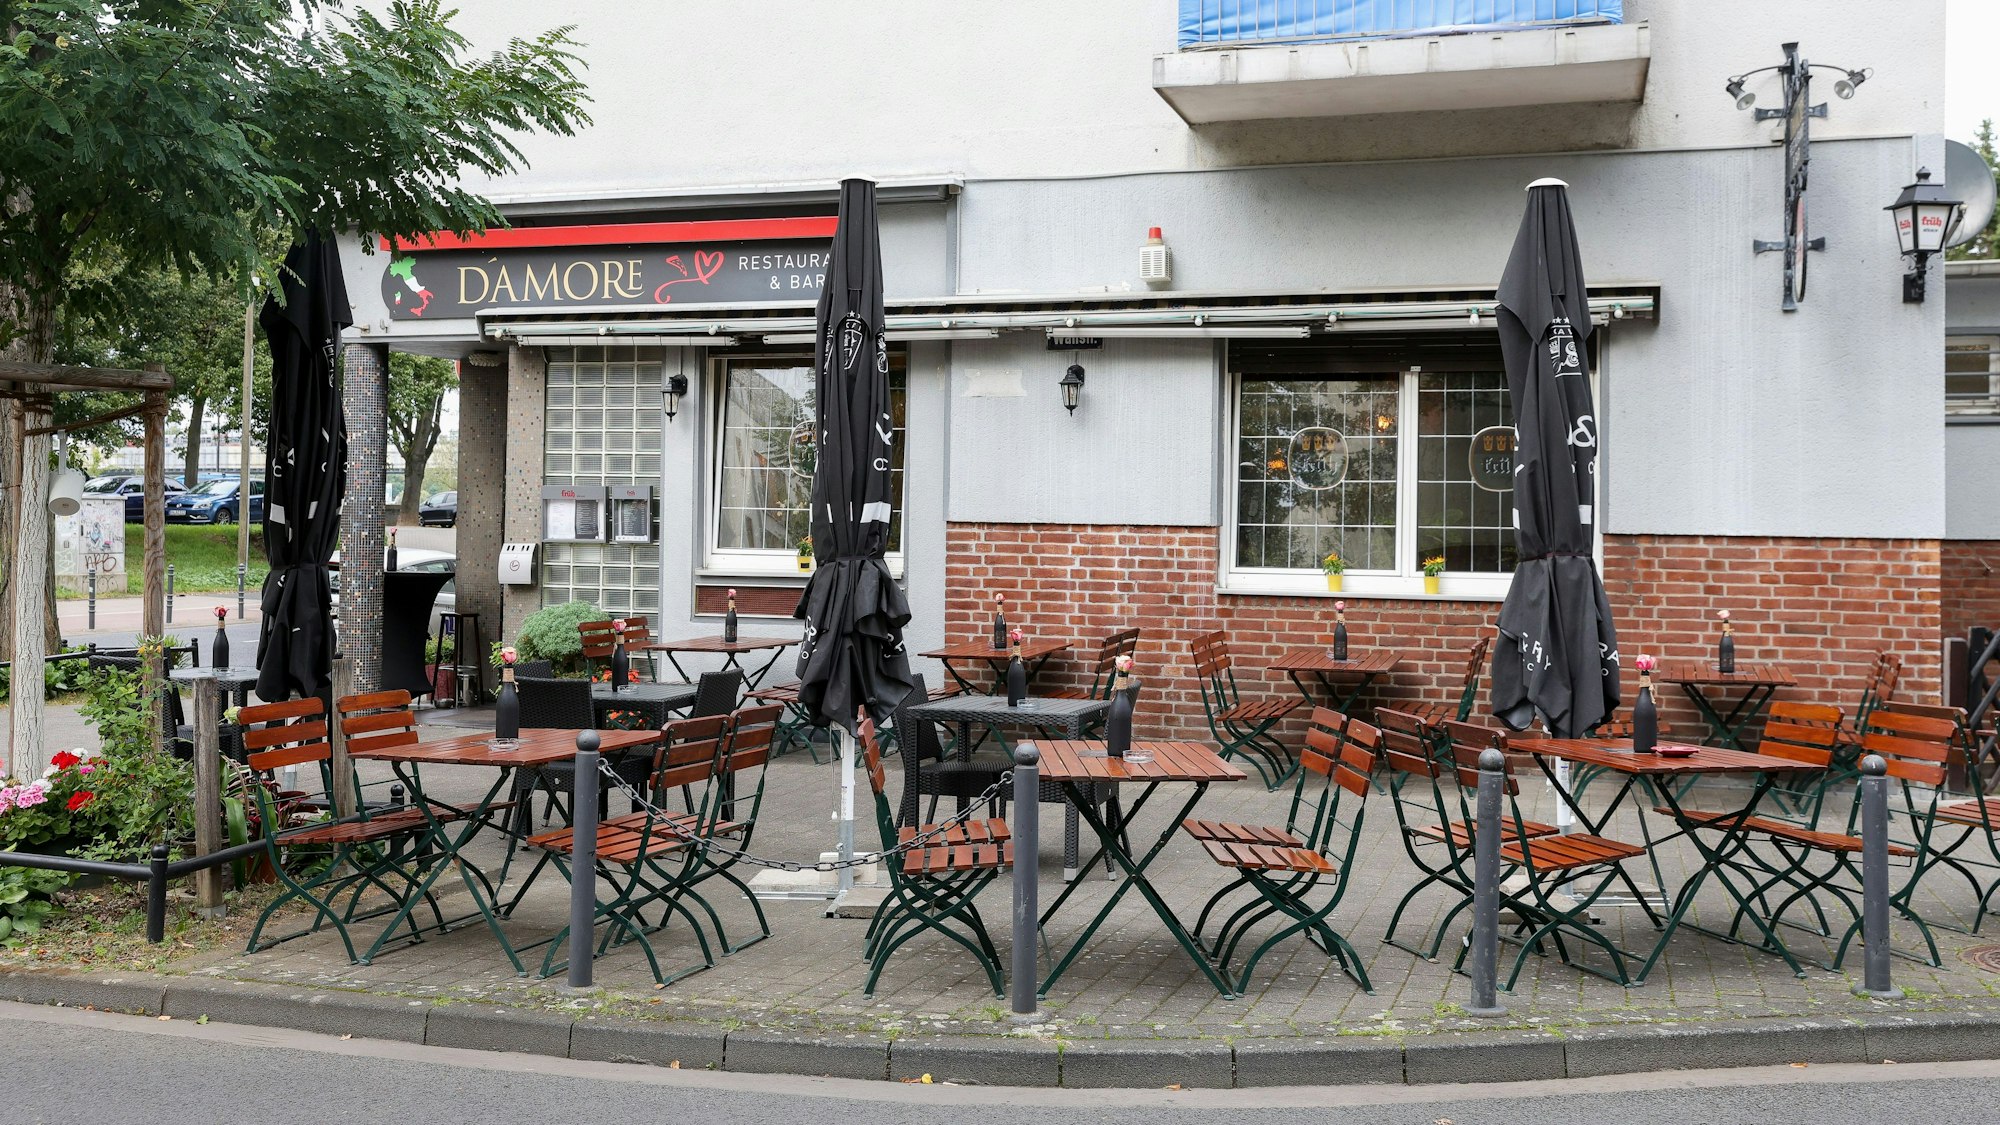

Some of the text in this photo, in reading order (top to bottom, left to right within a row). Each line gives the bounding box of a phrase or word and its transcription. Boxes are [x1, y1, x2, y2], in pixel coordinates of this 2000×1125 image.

[1922, 216, 1942, 227] früh
[739, 253, 831, 270] RESTAURA
[770, 274, 826, 289] & BAR
[1485, 457, 1511, 474] frü
[561, 490, 576, 498] früh
